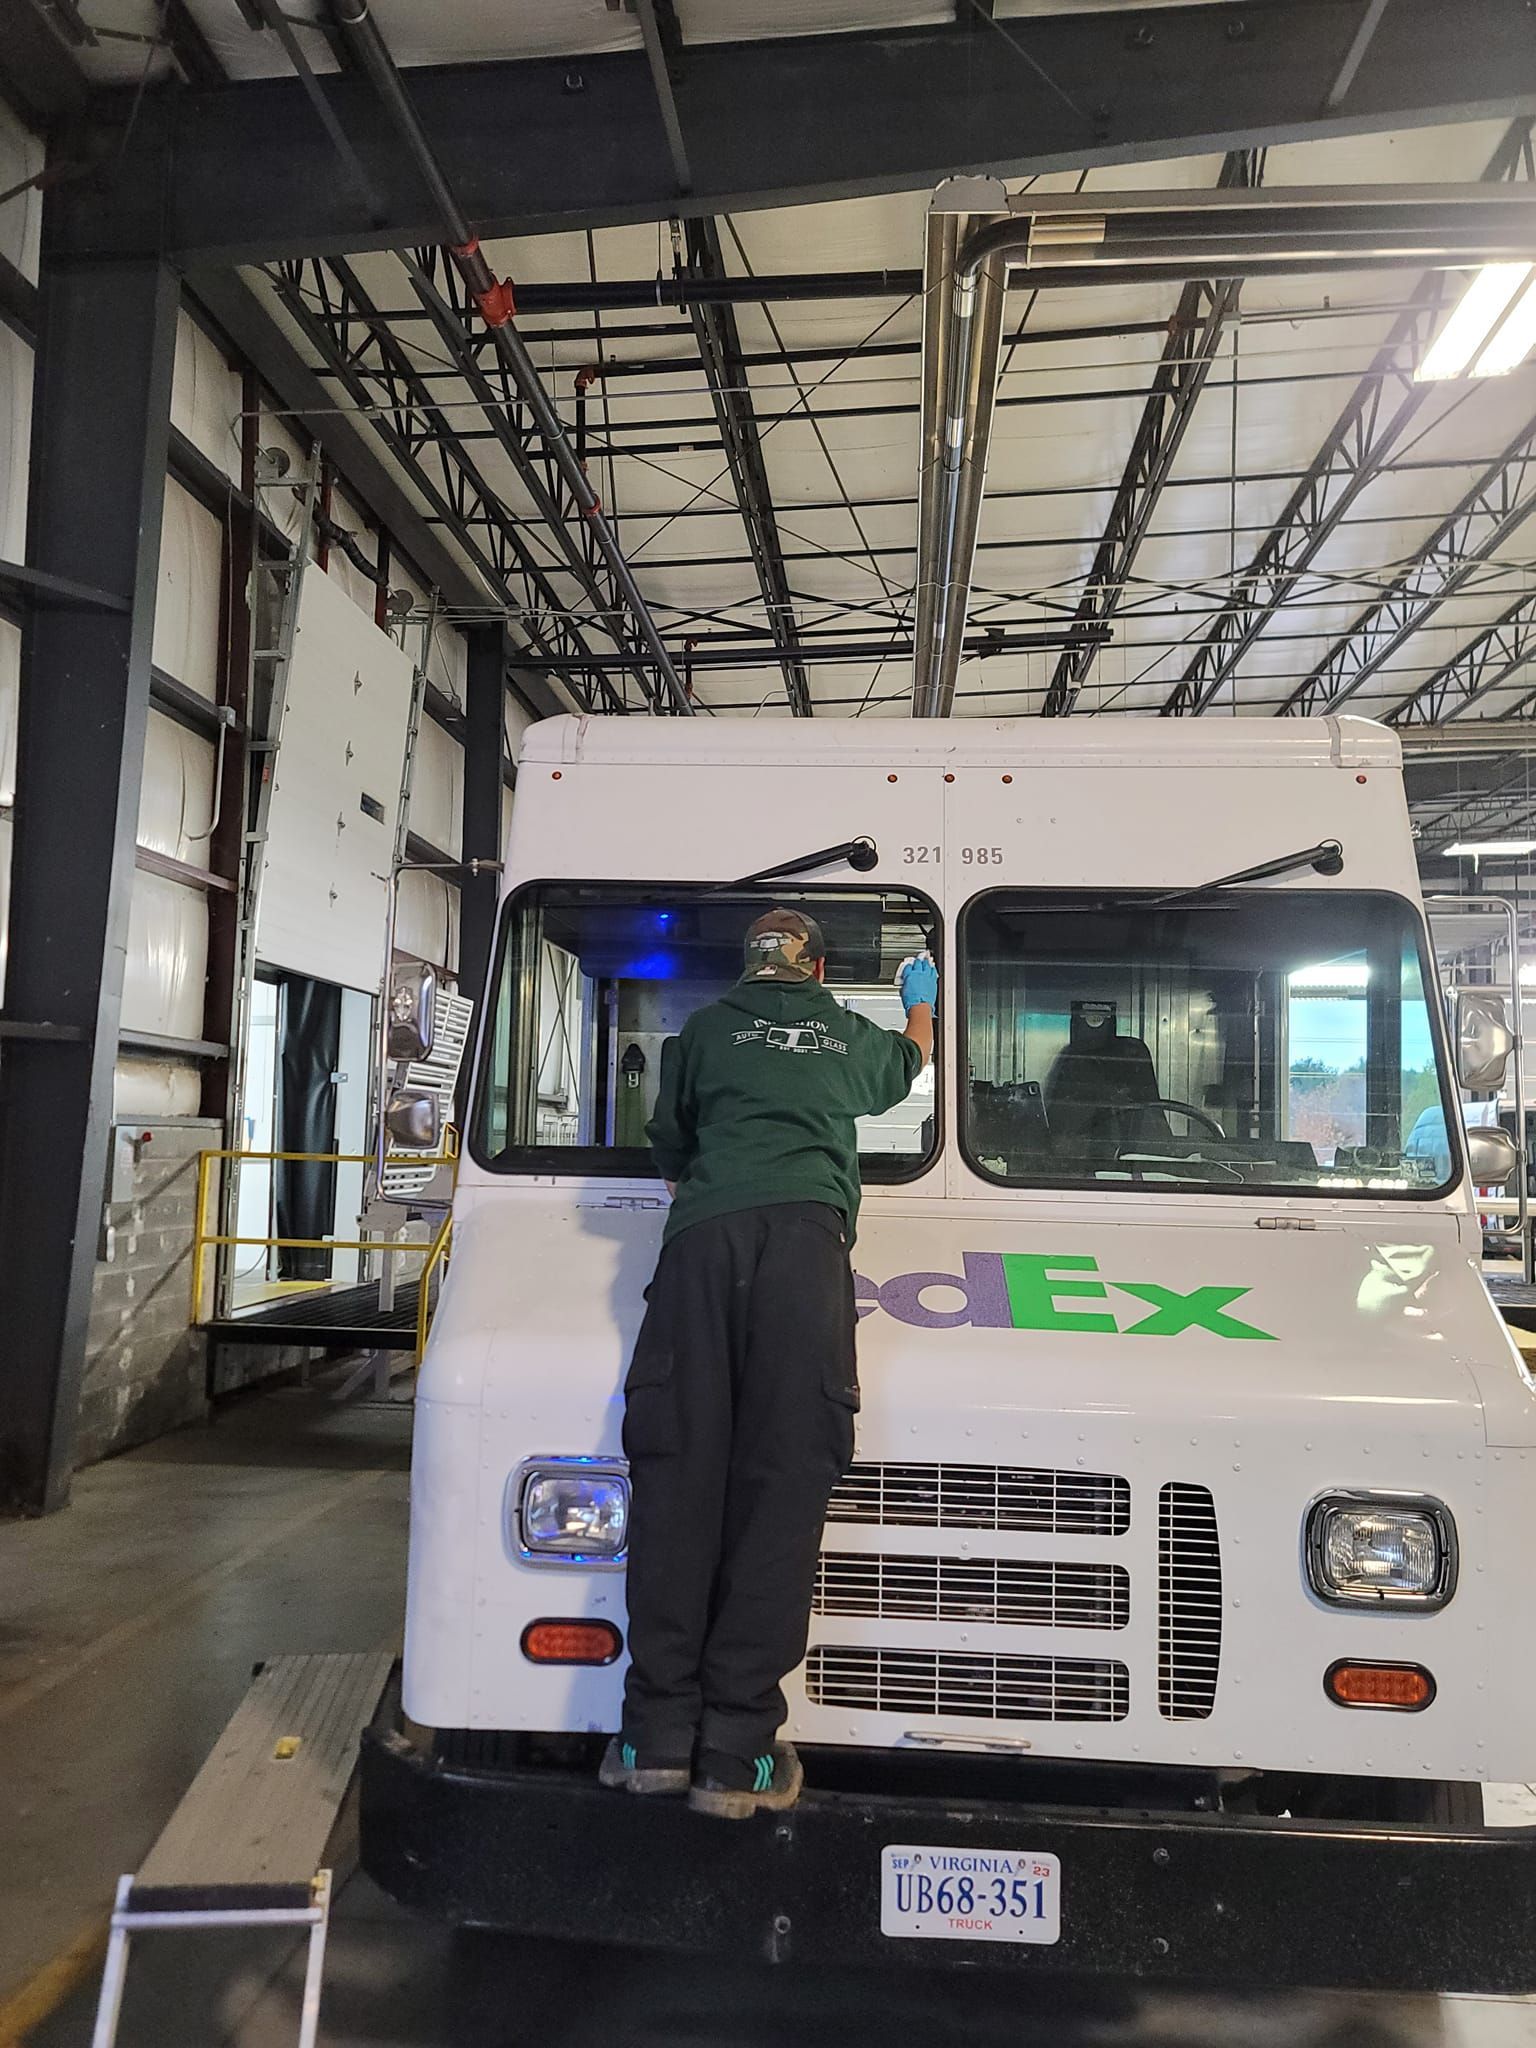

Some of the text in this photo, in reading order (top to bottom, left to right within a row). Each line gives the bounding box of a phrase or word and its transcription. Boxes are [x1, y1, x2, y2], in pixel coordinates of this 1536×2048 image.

[903, 846, 1003, 865] 321 985
[823, 1039, 847, 1052] GLASS
[892, 1858, 910, 1869] SEP
[929, 1855, 1014, 1874] VIRGINIA
[1032, 1866, 1050, 1877] 23
[895, 1873, 1047, 1919] UB68-351
[947, 1918, 993, 1930] TRUCK
